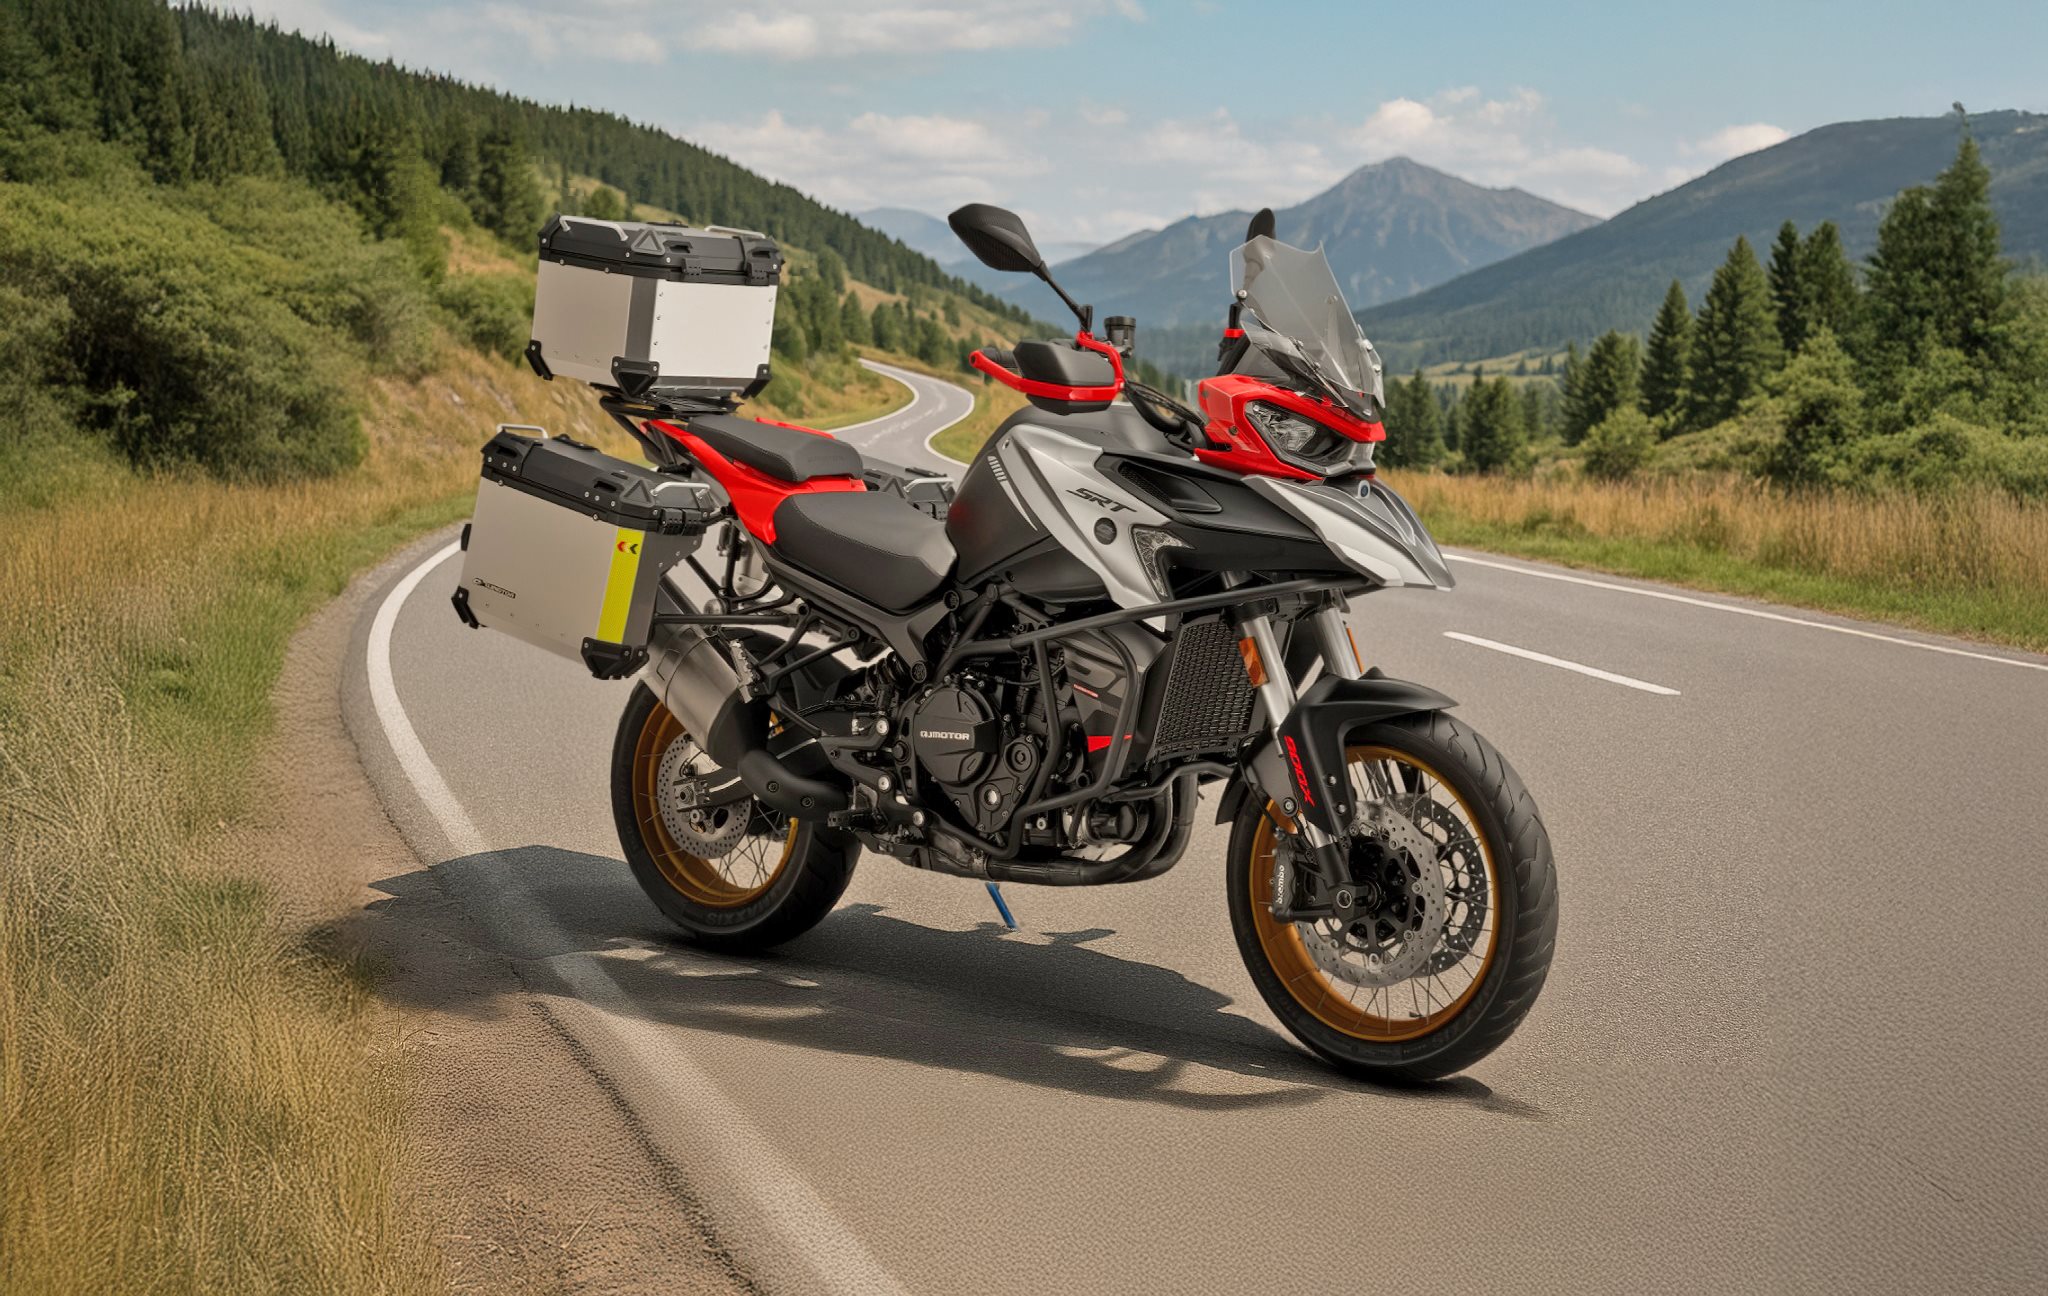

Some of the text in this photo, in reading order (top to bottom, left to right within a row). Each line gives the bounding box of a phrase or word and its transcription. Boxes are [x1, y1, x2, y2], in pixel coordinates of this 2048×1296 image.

[1066, 487, 1138, 512] SRT
[920, 730, 970, 741] QJMOTOR
[1275, 864, 1285, 905] brembo
